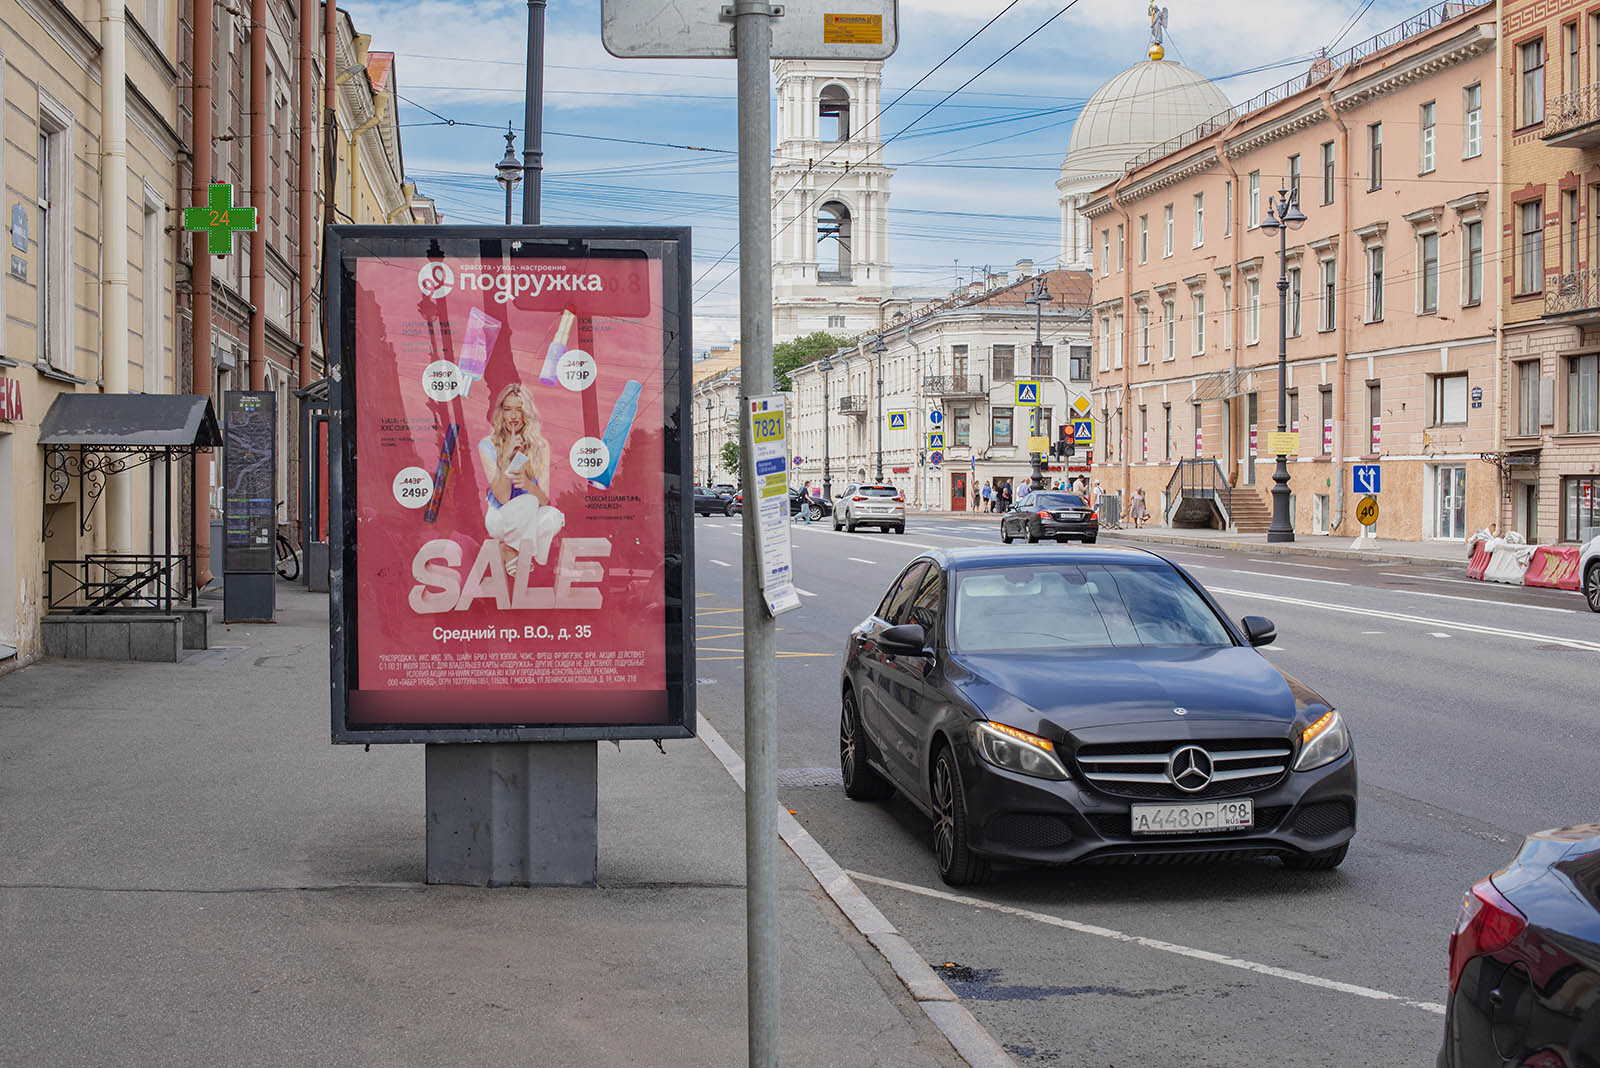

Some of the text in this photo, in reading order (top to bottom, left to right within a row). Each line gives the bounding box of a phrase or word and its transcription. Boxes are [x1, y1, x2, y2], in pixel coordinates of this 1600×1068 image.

[208, 210, 230, 227] 24
[460, 272, 603, 304] подружка
[754, 417, 782, 438] 7821
[1361, 506, 1375, 518] 40
[408, 537, 612, 614] SALE
[432, 625, 496, 644] Средний
[499, 629, 521, 643] пр.
[557, 628, 571, 641] д.
[575, 625, 592, 639] 35
[1220, 803, 1247, 820] 198
